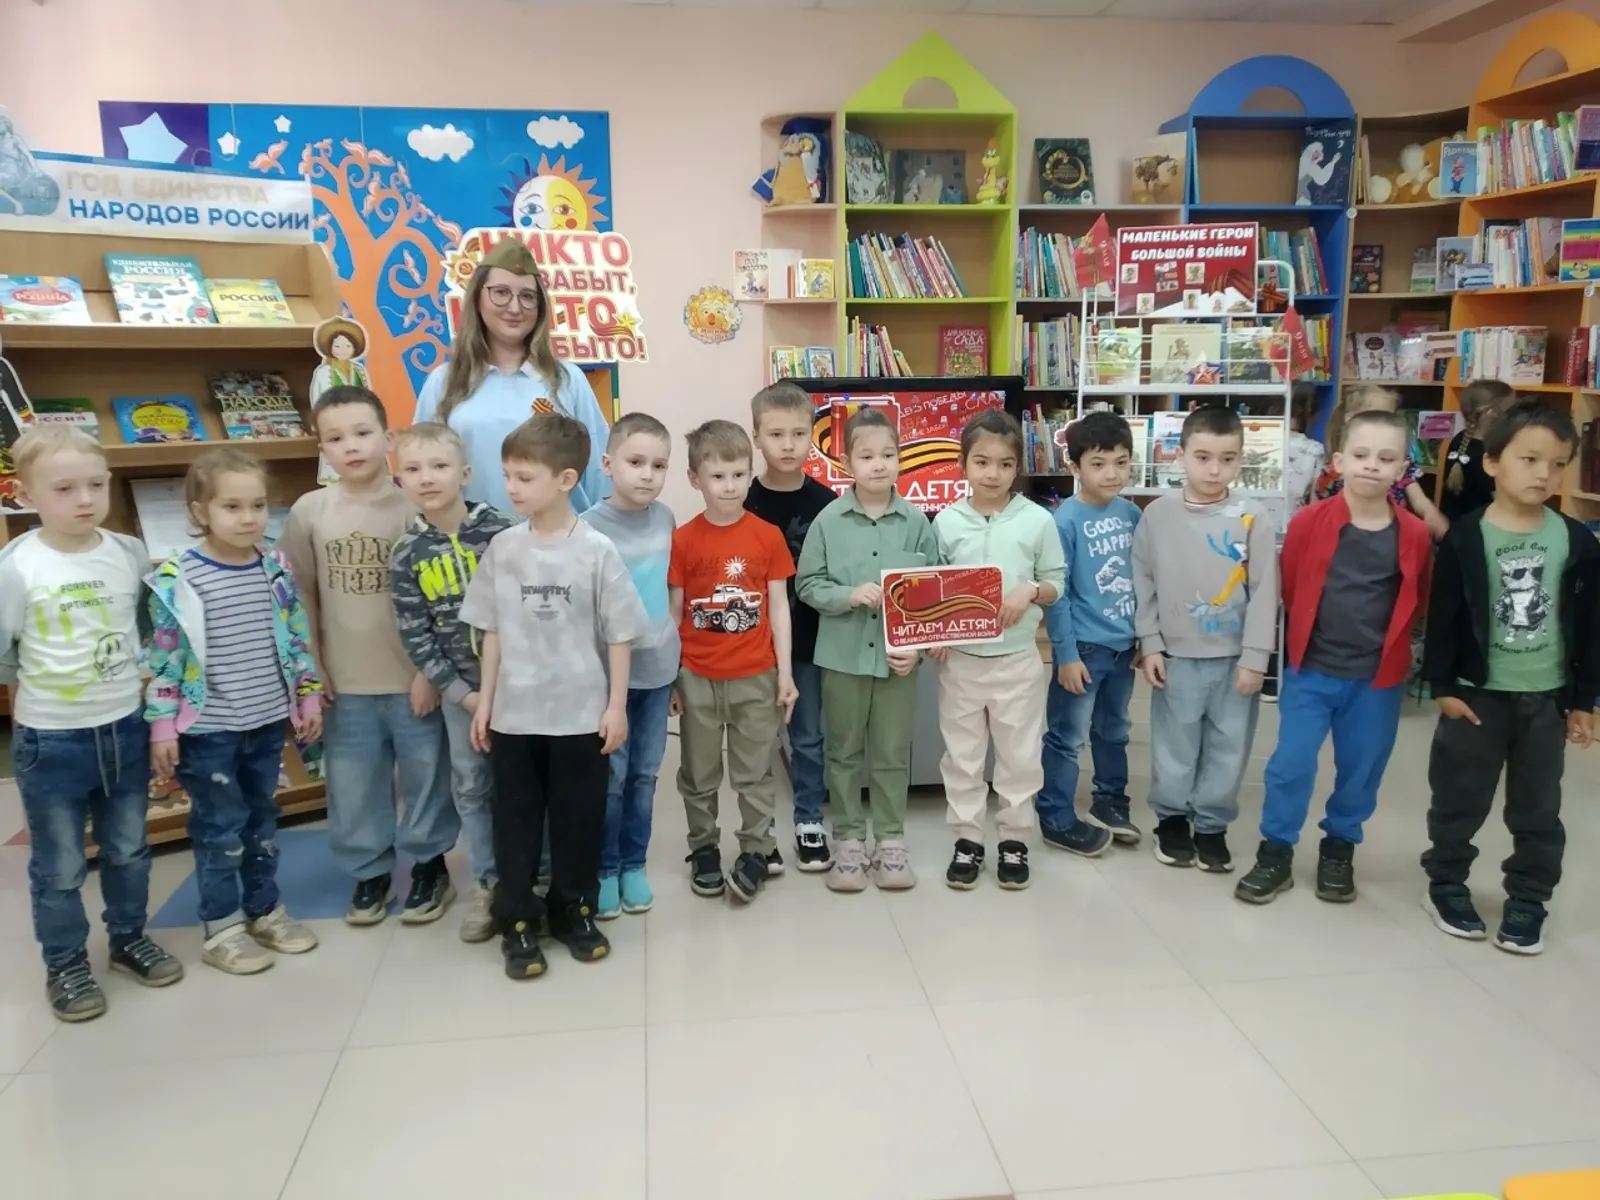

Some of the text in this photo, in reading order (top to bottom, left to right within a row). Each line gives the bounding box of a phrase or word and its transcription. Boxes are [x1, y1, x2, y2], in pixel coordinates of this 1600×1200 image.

[65, 170, 268, 203] ГОД ЕДИНСТВА
[69, 198, 309, 230] НАРОДОВ РОССИИ
[1122, 227, 1254, 243] МАЛЕНЬКИЕ ГЕРОИ
[1131, 244, 1248, 261] БОЛЬШОЙ ВОЙНЫ
[123, 266, 186, 275] РОССИЯ
[219, 293, 279, 302] РОССИЯ
[551, 336, 645, 361] БЫТО!
[215, 395, 293, 409] НАРОДЫ
[903, 479, 974, 501] ДЕТЯ
[1083, 516, 1122, 538] GOOD
[1087, 532, 1133, 558] HAPPE
[1495, 542, 1526, 557] Cool
[60, 580, 106, 594] FOREVER
[59, 596, 114, 612] OPTIMISTIC
[892, 618, 997, 637] ЧИТАЕМ ДЕТЯМ
